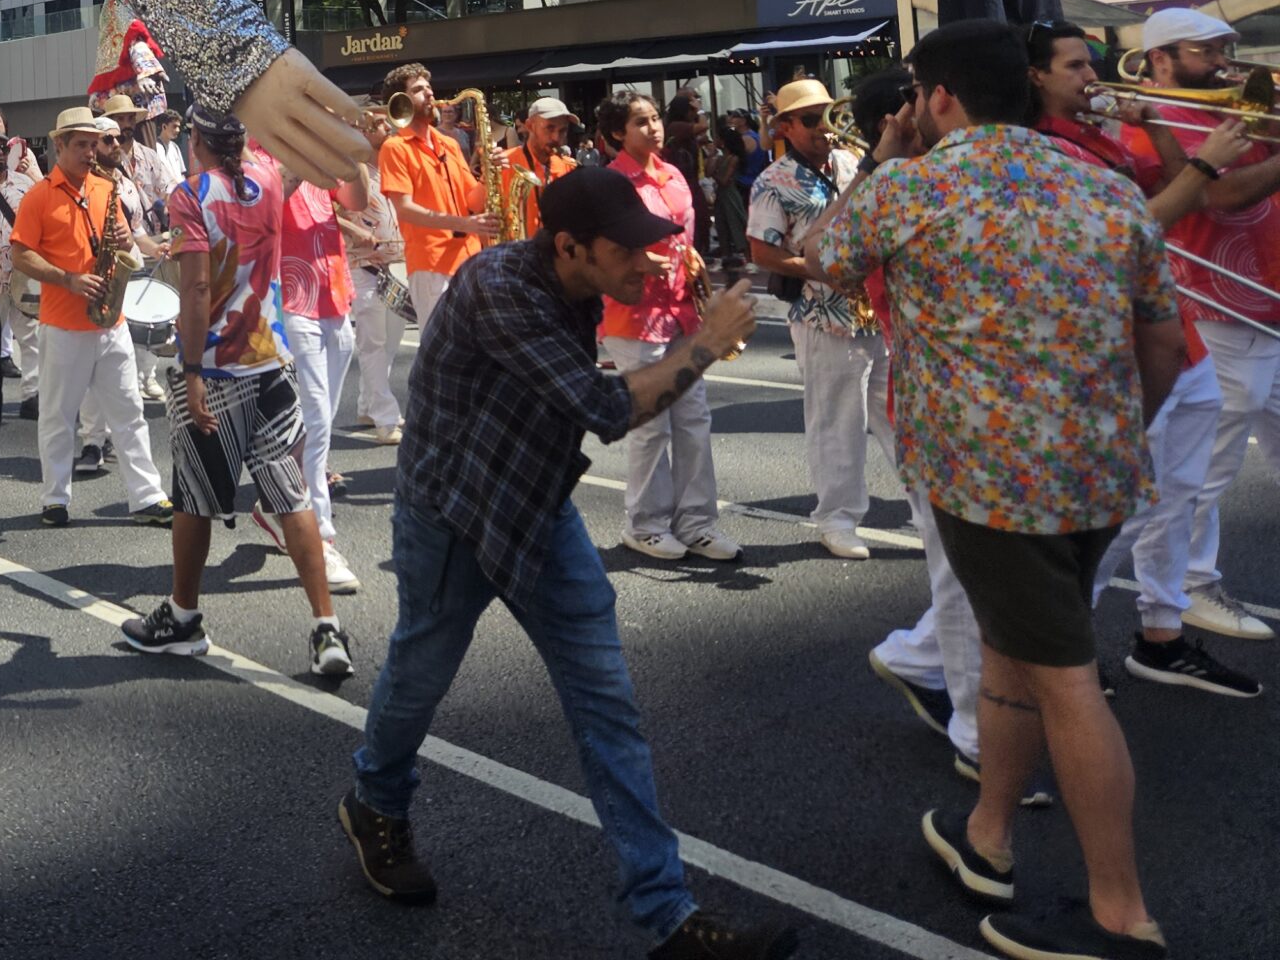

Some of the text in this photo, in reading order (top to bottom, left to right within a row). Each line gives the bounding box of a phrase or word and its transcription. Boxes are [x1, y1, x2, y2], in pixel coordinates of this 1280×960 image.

[842, 7, 865, 15] STUDIOS
[341, 33, 403, 56] Jardan
[154, 627, 174, 639] FILA
